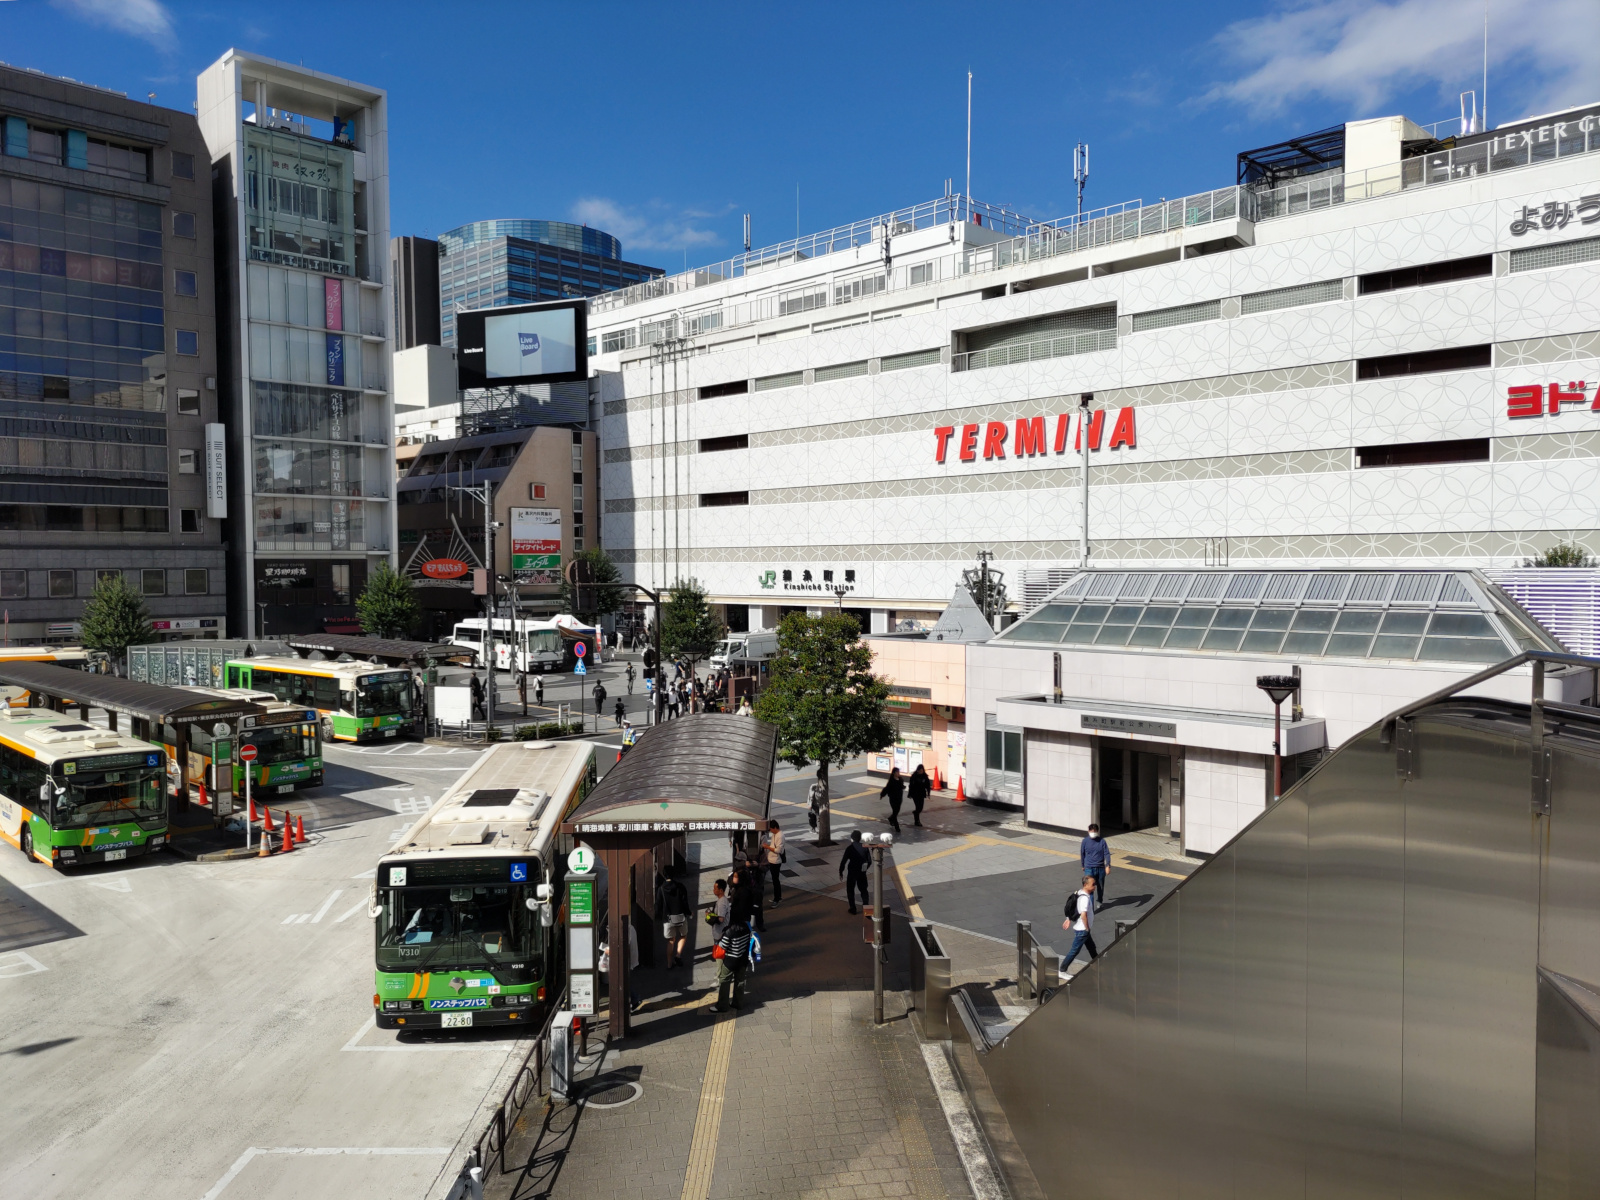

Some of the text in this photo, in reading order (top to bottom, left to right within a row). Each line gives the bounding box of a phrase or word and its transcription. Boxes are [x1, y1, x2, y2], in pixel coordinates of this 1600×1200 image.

[1493, 121, 1567, 156] JEXER
[520, 343, 539, 351] Board
[1507, 380, 1600, 419] ヨド
[934, 406, 1136, 463] TERMINA
[215, 452, 224, 500] SUIT SELECT
[758, 570, 776, 585] JR
[824, 583, 855, 591] Station
[574, 824, 580, 832] 1
[95, 840, 134, 851] ノンステップバス
[577, 851, 583, 864] 1
[400, 948, 420, 956] V310
[430, 998, 487, 1008] ノンステップバス
[447, 1016, 472, 1027] 22-80
